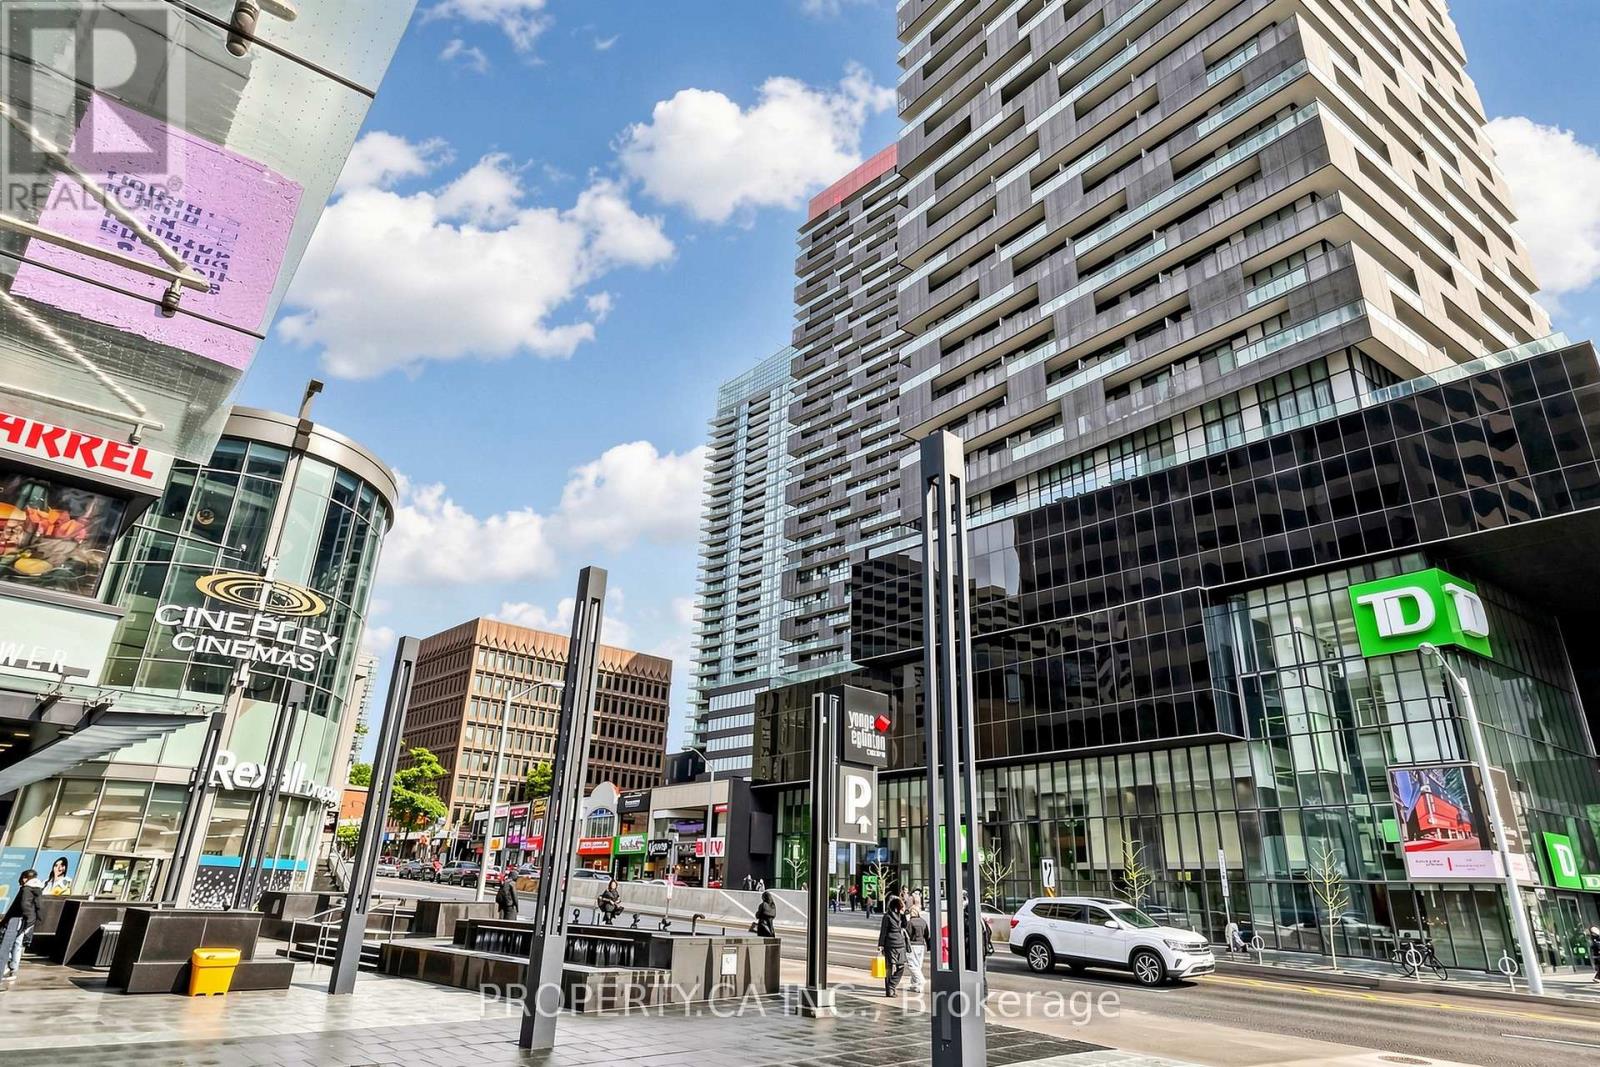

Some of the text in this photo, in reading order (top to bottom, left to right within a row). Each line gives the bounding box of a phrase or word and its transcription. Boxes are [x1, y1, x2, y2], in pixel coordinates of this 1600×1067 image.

[155, 604, 340, 656] CINEPLEX
[1357, 586, 1435, 638] TD
[172, 632, 316, 672] CINEMAS
[848, 711, 875, 731] yonge
[851, 728, 886, 751] eglinton
[845, 775, 872, 824] P
